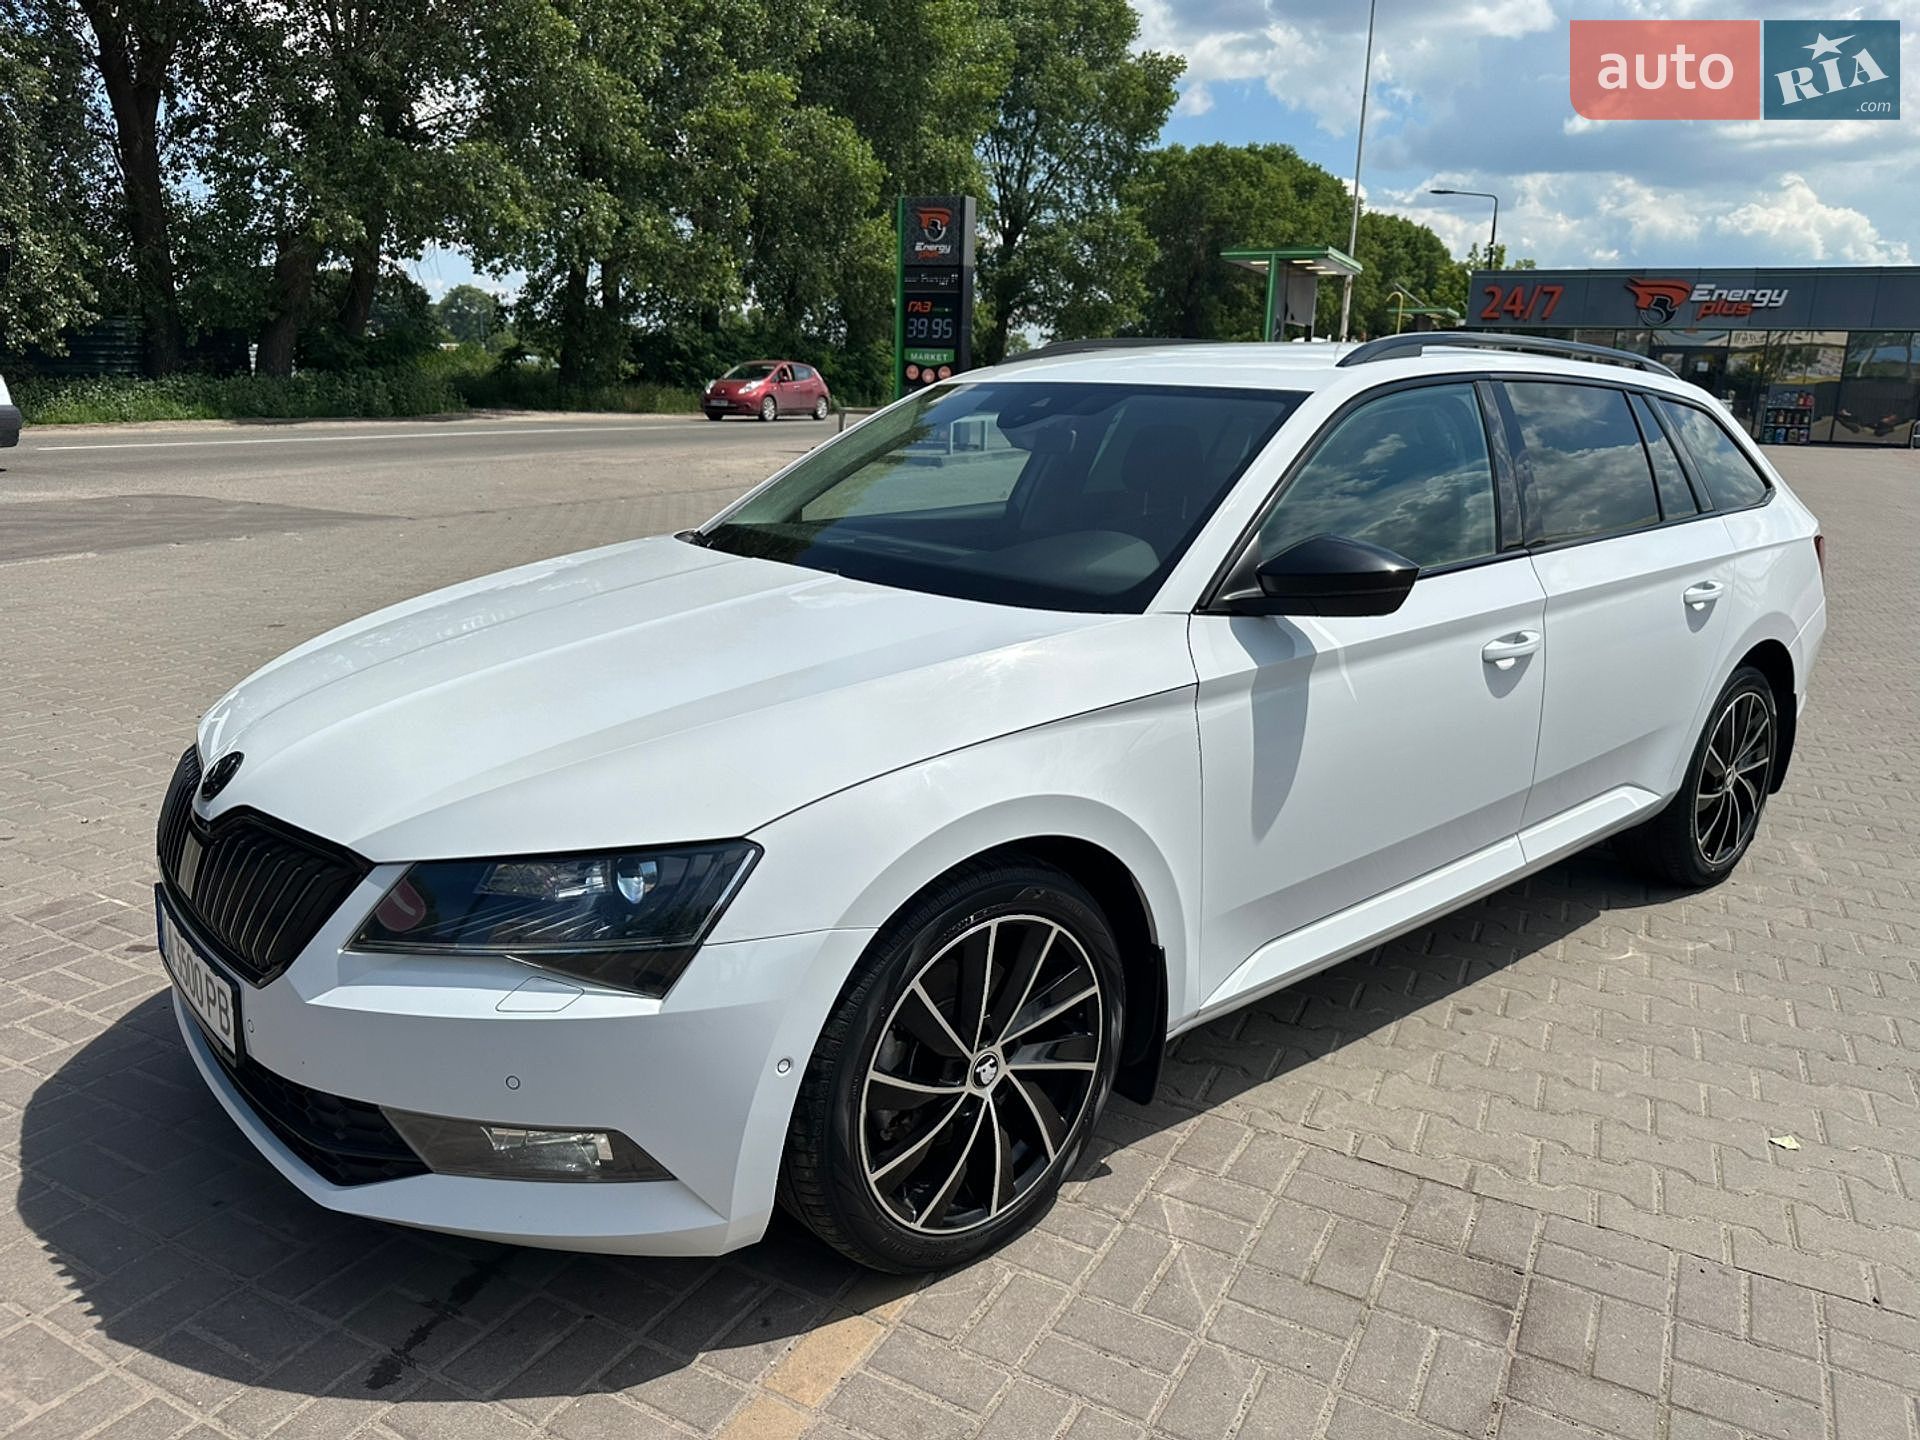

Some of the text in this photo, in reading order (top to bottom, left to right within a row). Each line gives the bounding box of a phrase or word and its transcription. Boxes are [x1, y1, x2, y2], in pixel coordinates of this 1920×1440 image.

[915, 242, 951, 254] Energy
[1481, 284, 1564, 321] 24/7
[1690, 283, 1790, 308] Energy
[1695, 300, 1754, 321] plus
[910, 352, 949, 361] MARKET
